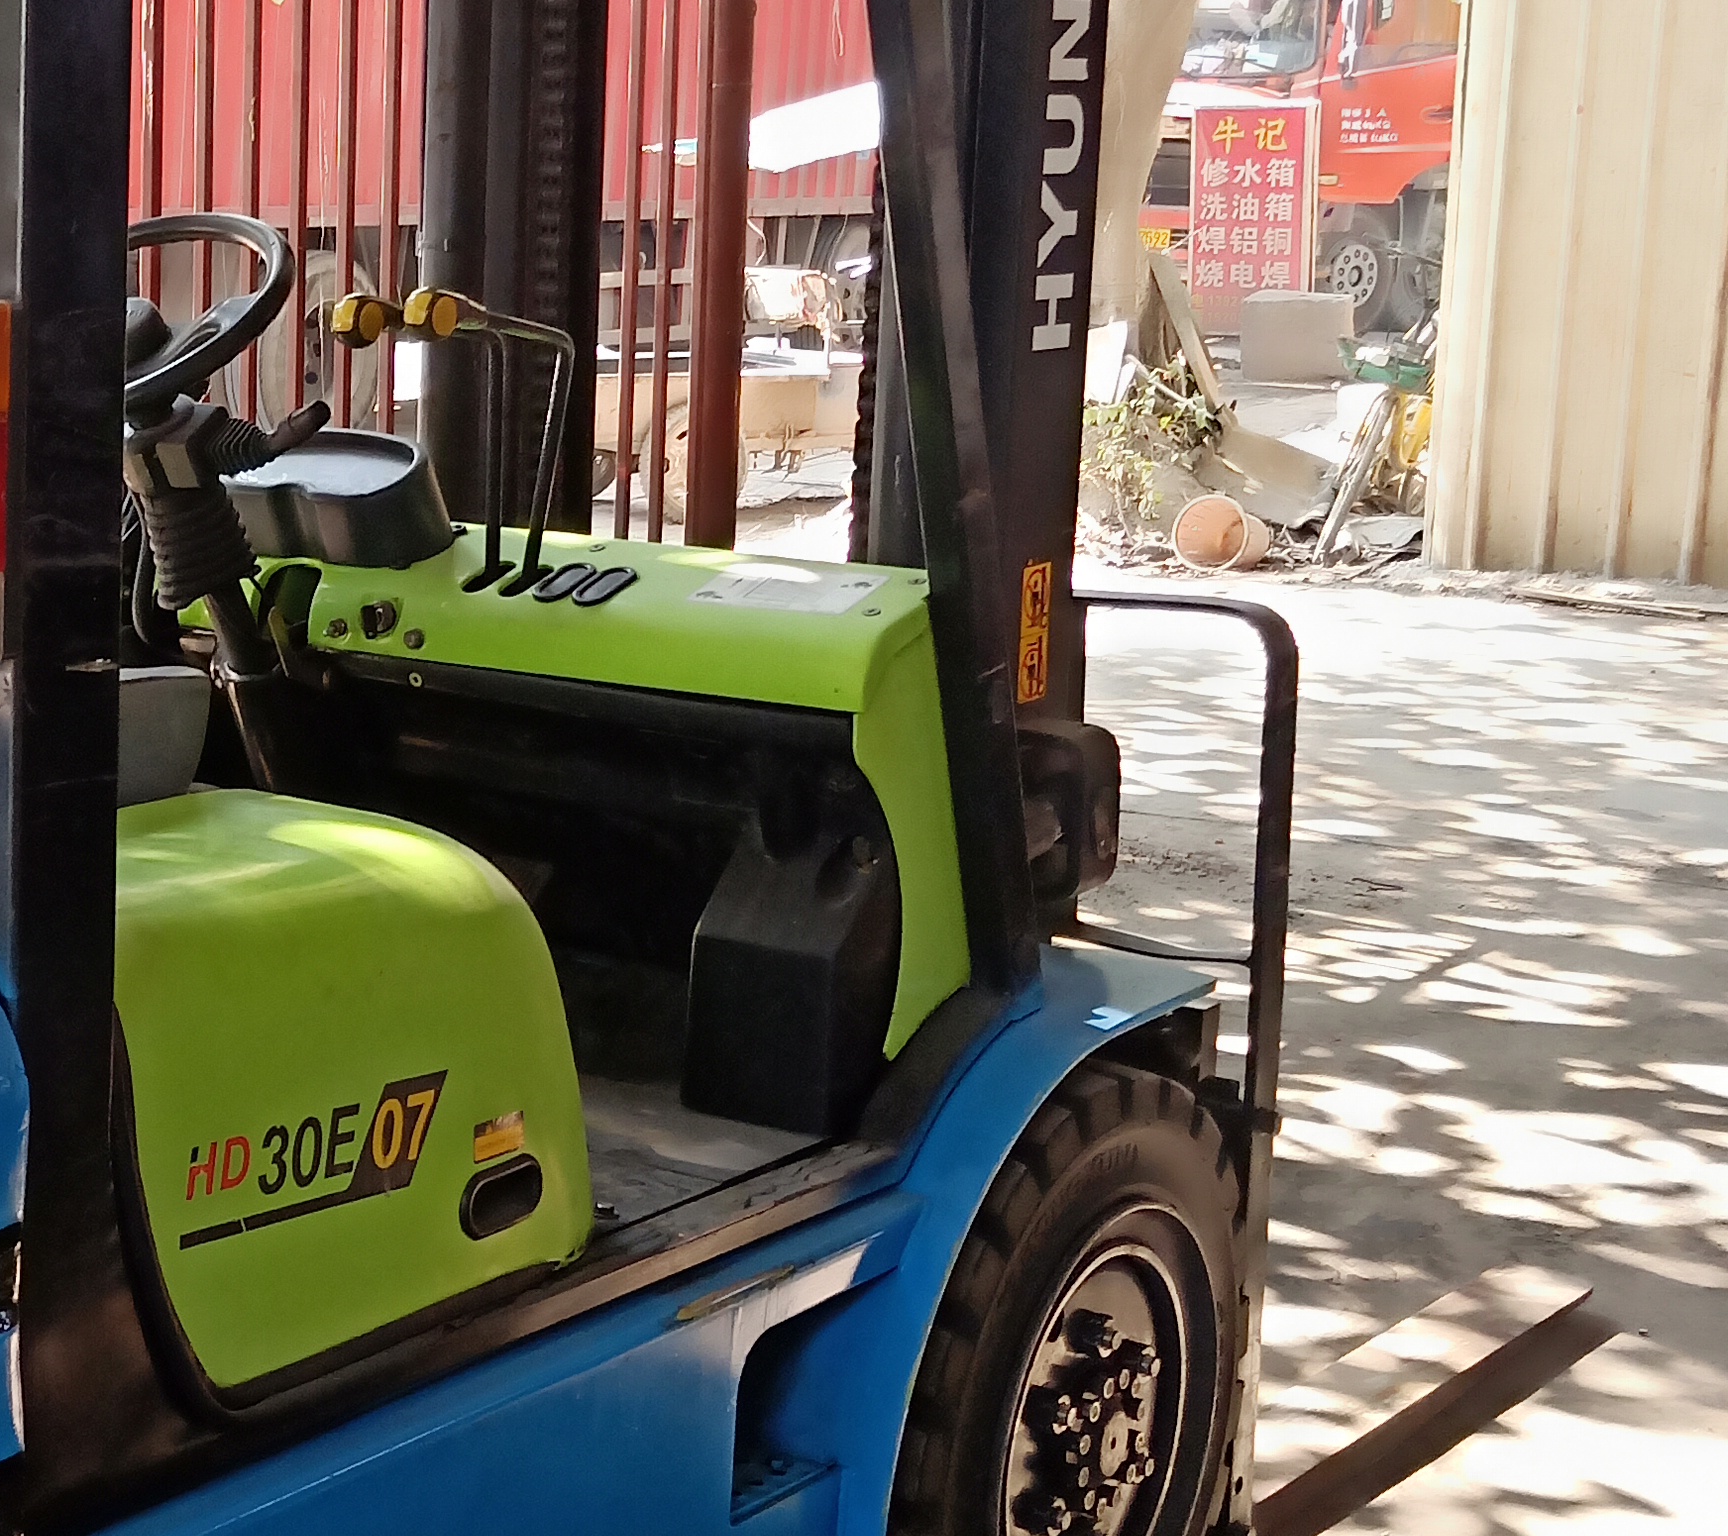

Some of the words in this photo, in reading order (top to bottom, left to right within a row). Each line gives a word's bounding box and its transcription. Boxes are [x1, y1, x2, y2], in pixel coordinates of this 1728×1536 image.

[1211, 115, 1288, 154] 牛记
[1200, 157, 1296, 188] 修水箱
[1199, 192, 1294, 222] 洗油箱
[1197, 225, 1292, 255] 焊铝铜
[1194, 259, 1291, 289] 烧电焊
